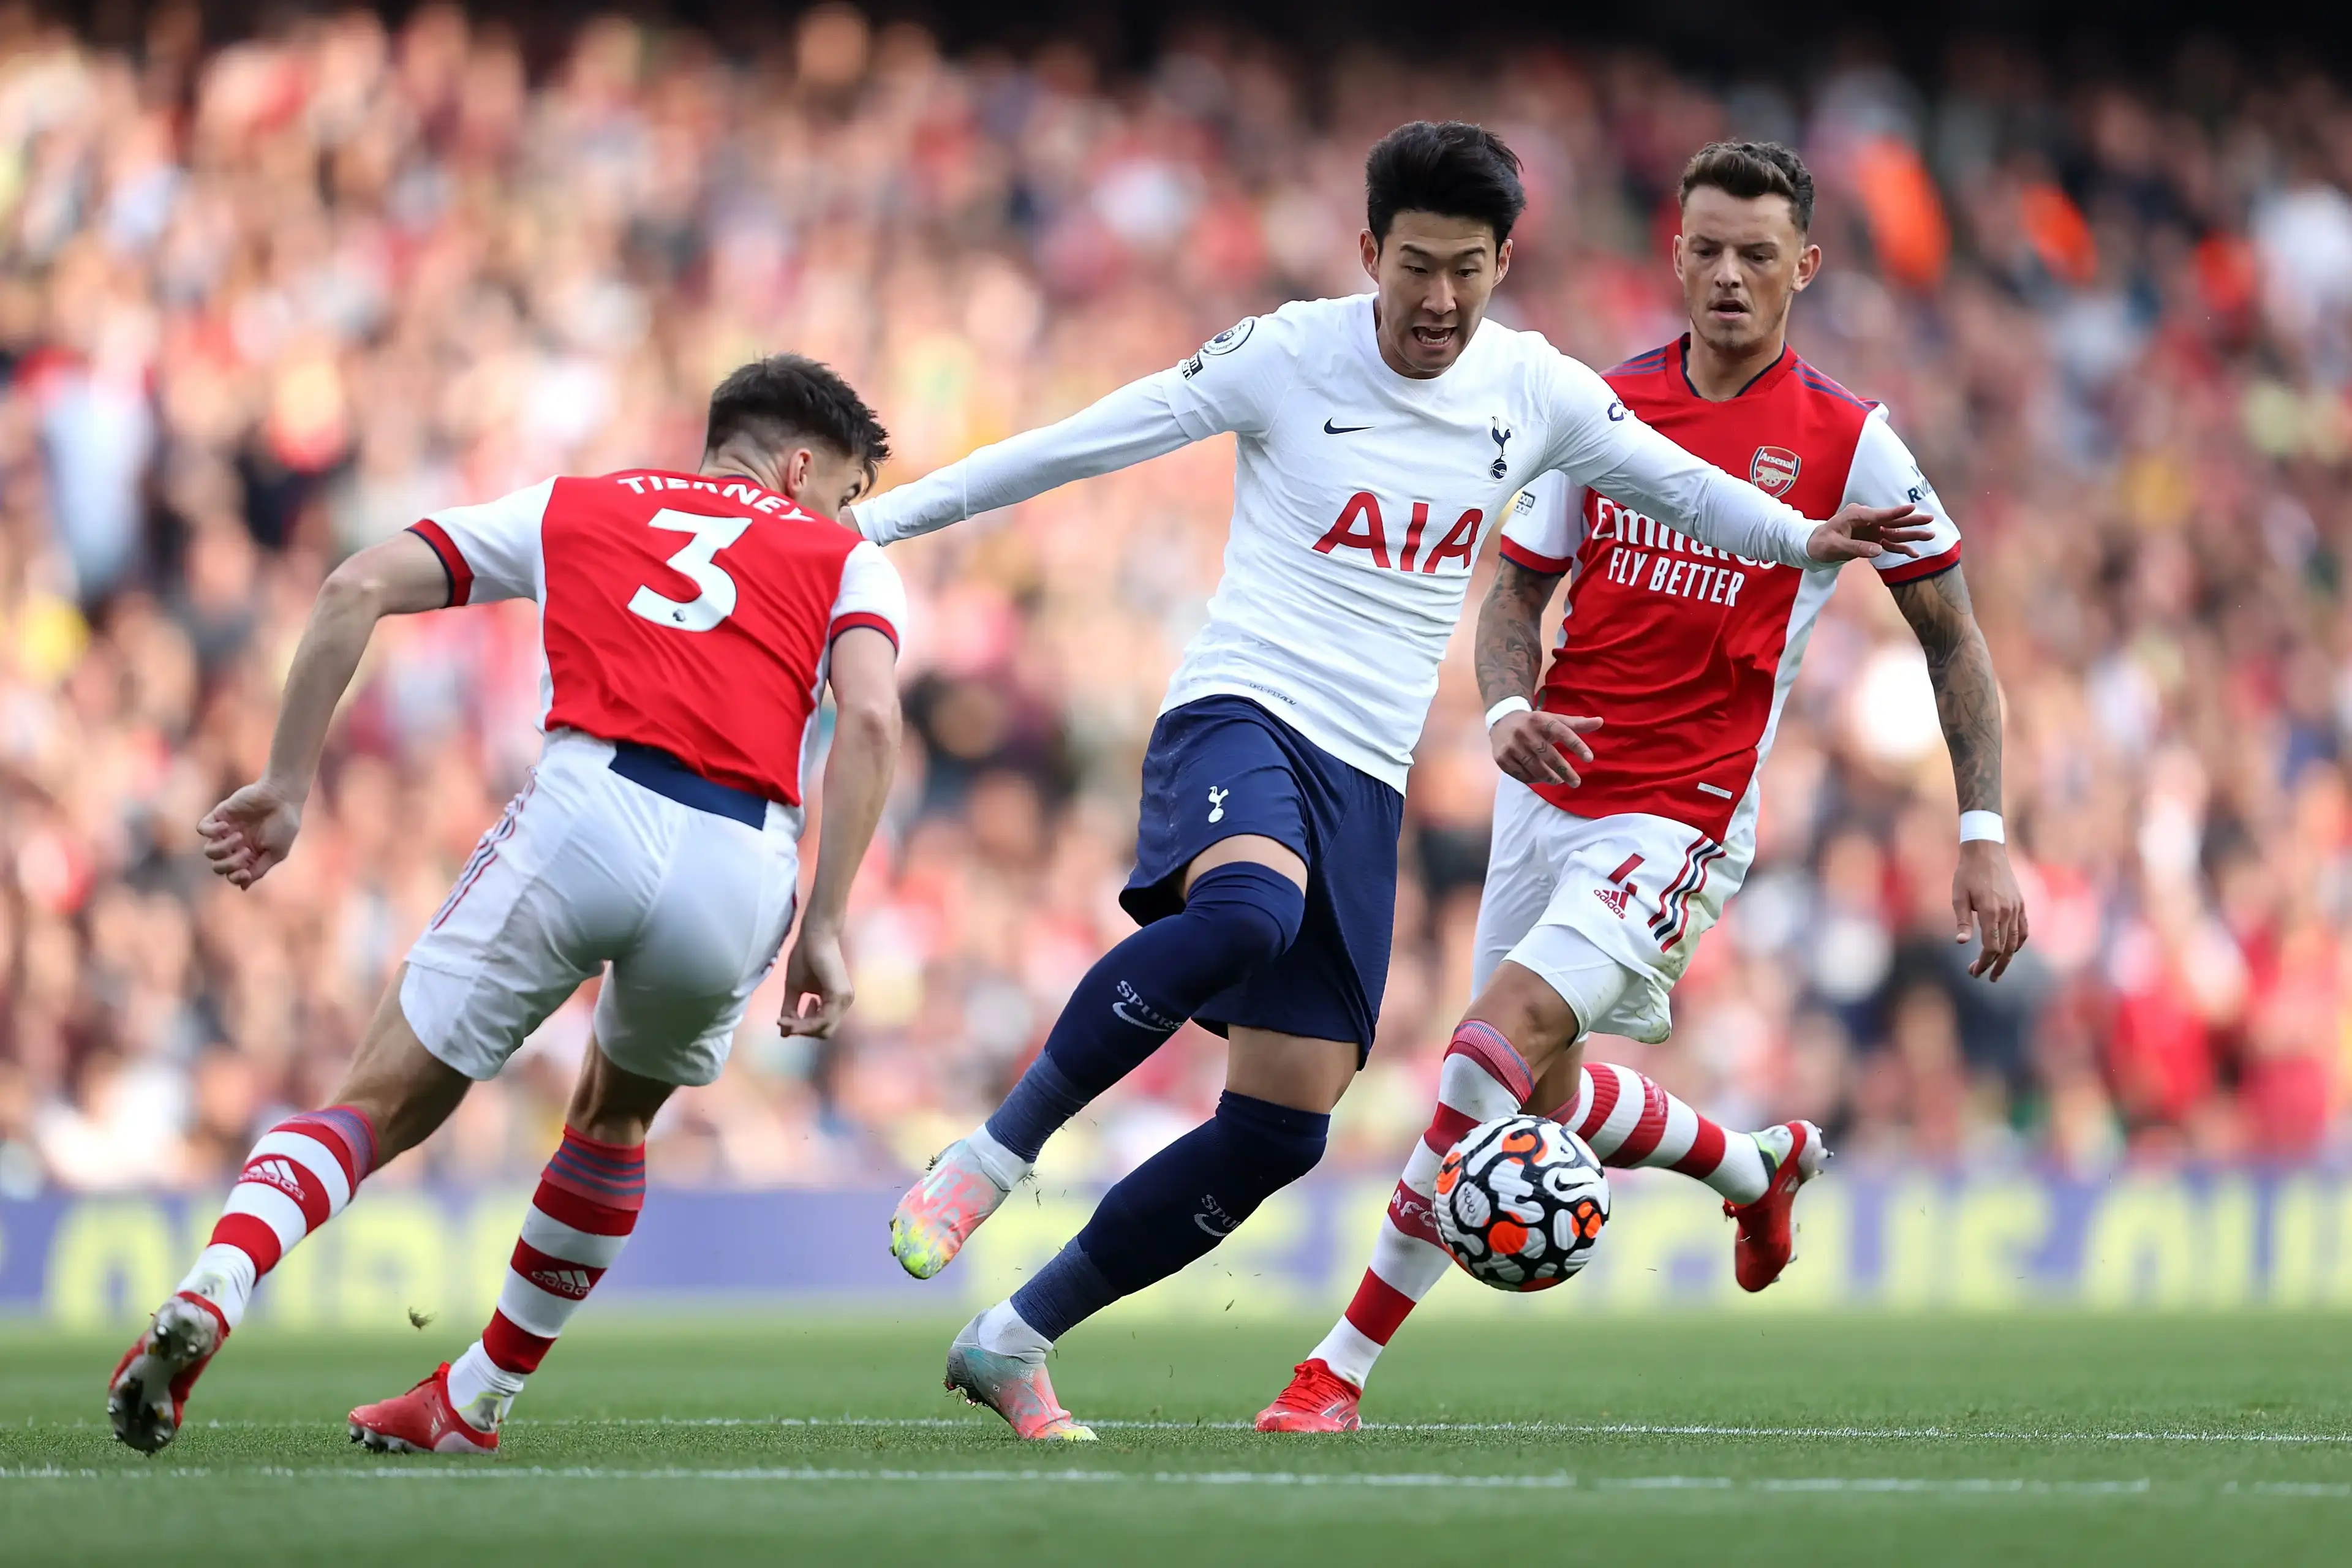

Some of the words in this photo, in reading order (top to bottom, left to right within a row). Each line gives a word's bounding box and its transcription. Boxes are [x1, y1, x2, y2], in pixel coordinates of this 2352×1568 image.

[1759, 452, 1795, 470] Arsenal
[1312, 491, 1484, 574] AIA
[627, 508, 753, 632] 3
[1607, 546, 1648, 586] FLY
[1648, 556, 1745, 607] BETTER
[1593, 889, 1626, 919] adidas
[238, 1170, 306, 1201] adidas
